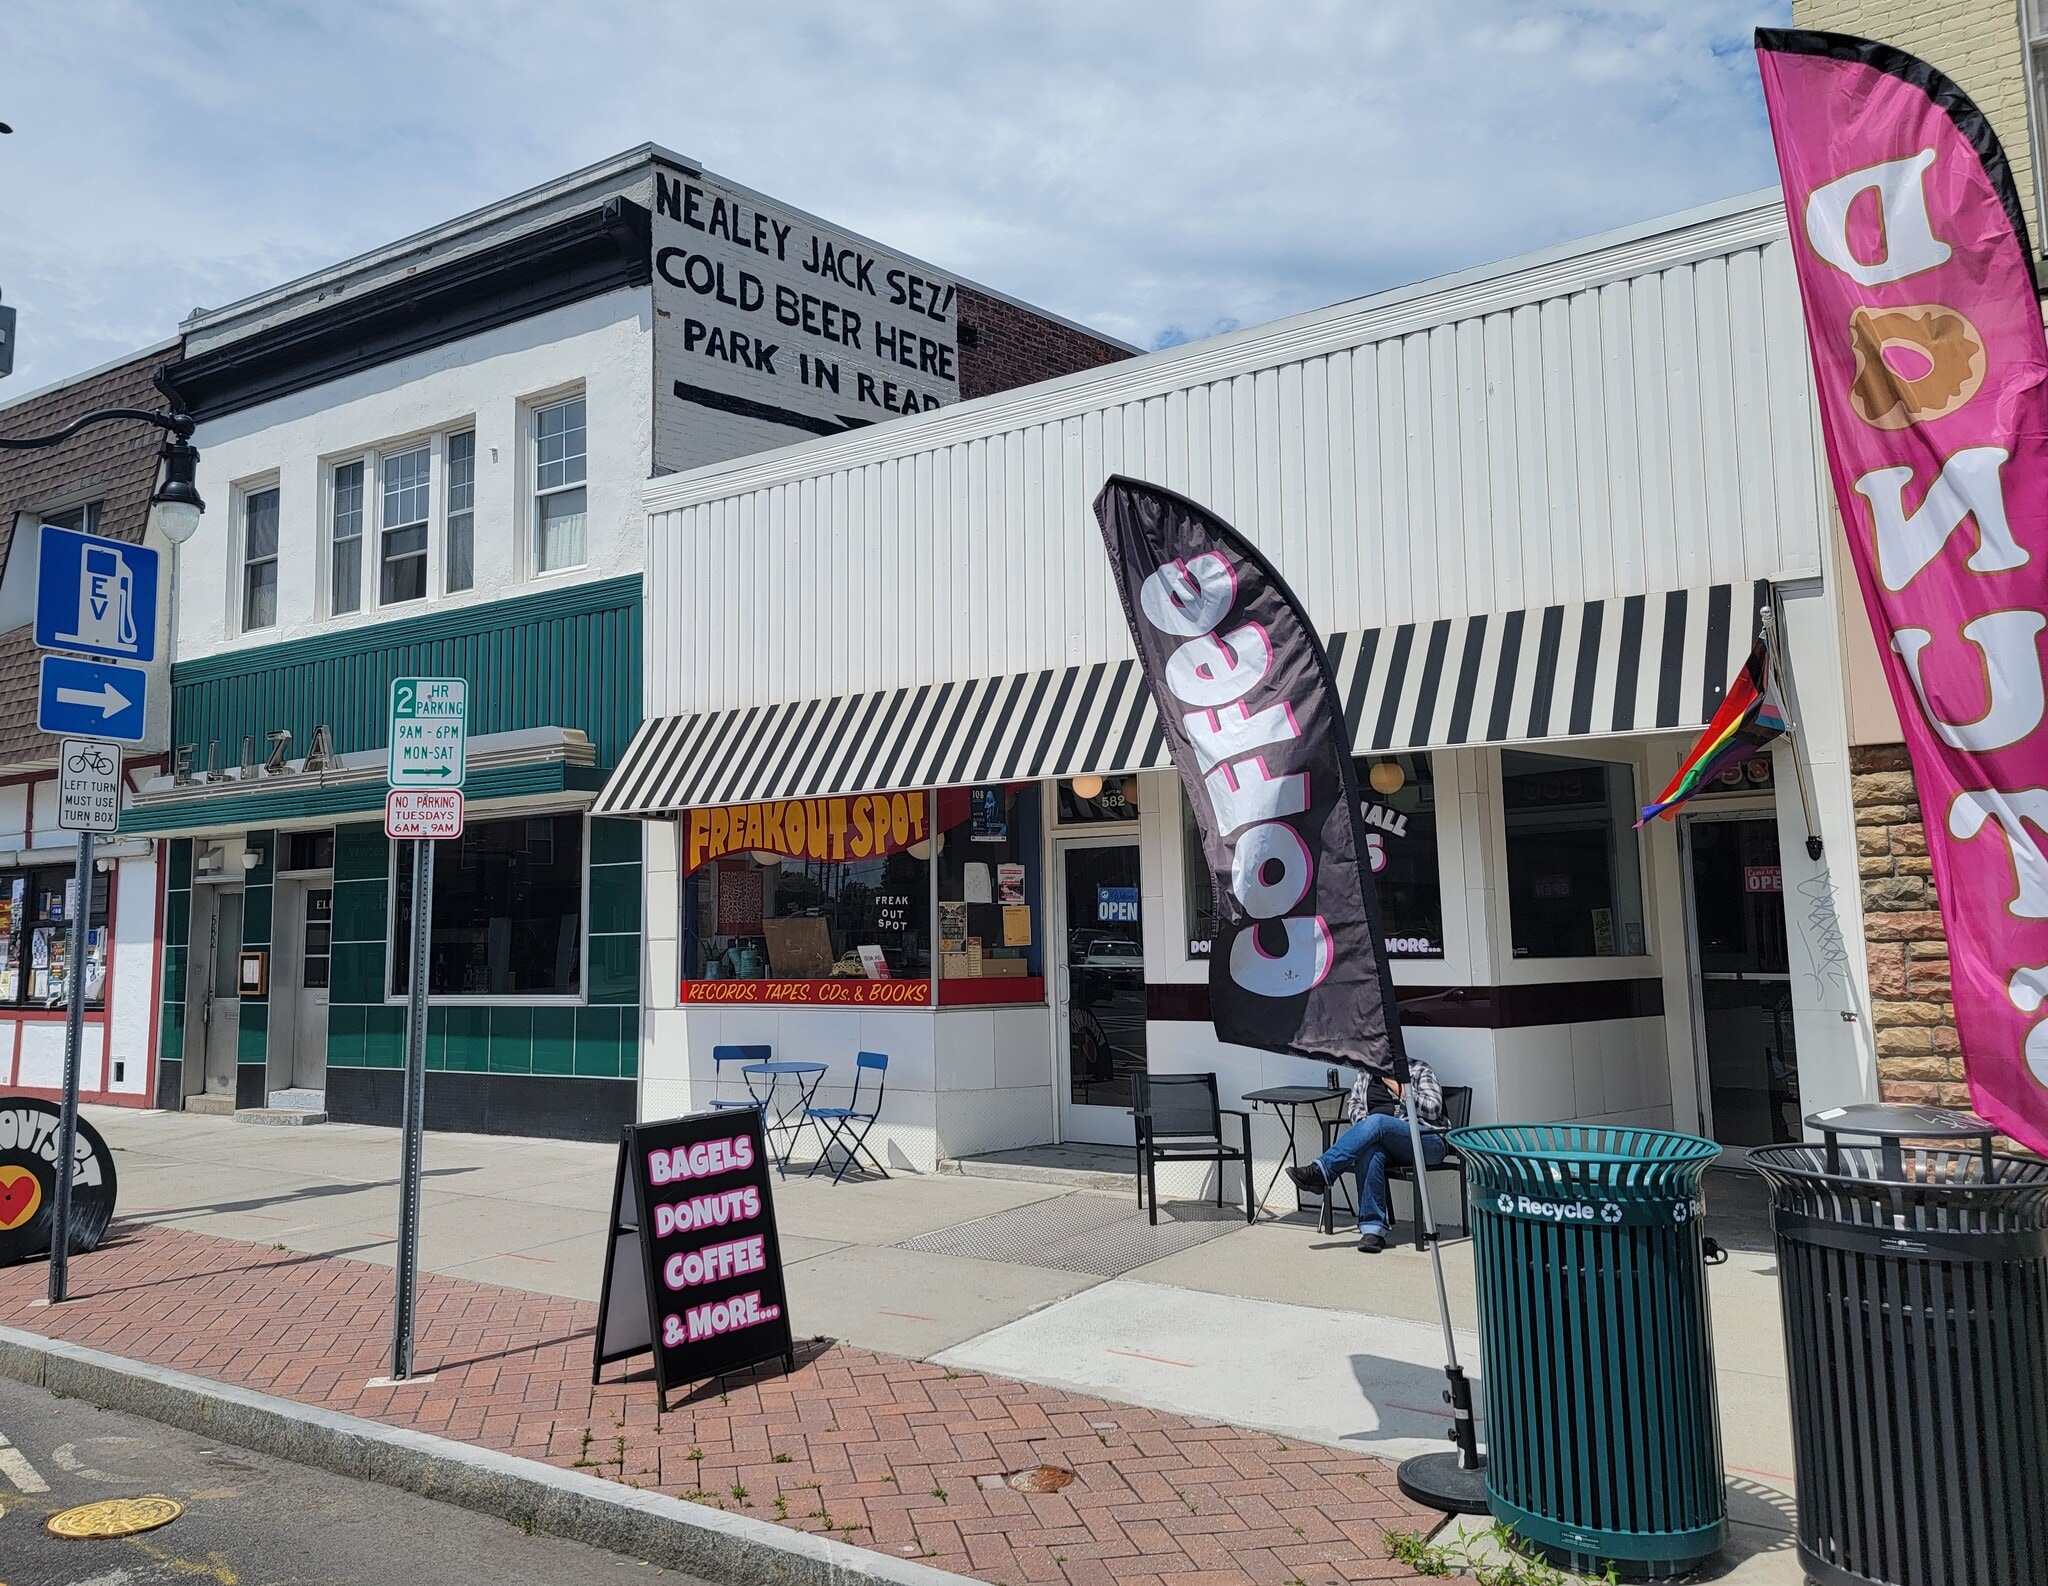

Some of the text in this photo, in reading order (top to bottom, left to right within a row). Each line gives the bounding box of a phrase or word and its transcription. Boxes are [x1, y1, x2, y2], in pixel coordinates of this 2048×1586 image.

[656, 172, 956, 322] NEALEY JACK SEZ!
[656, 247, 956, 381] COLD BEER HERE
[684, 318, 779, 375] PARK
[800, 353, 839, 394] IN
[431, 684, 449, 698] HR
[397, 686, 413, 713] 2
[416, 701, 463, 715] PARKING
[399, 725, 422, 739] 9AM
[436, 725, 459, 739] 6PM
[173, 724, 343, 788] ELIZA
[403, 746, 454, 760] MON-SAT
[64, 779, 116, 793] LEFT TURN
[65, 795, 114, 808] MUST USE
[395, 796, 455, 808] NO PARKING
[1101, 795, 1126, 808] 582
[64, 810, 114, 824] TURN BOX
[395, 811, 454, 820] TUESDAYS
[394, 823, 419, 833] 6AM
[431, 823, 454, 833] 9AM
[1749, 875, 1782, 890] OPE
[875, 896, 909, 905] FREAK
[881, 908, 904, 919] OUT
[1099, 901, 1138, 921] OPEN
[878, 918, 908, 931] SPOT
[854, 985, 864, 1002] &
[868, 983, 928, 1002] BOOKS
[649, 1136, 753, 1184] BAGELS
[655, 1187, 760, 1236] DONUTS
[1517, 1195, 1595, 1222] Recycle
[665, 1236, 765, 1289] COFFEE
[663, 1292, 779, 1347] & MORE...
